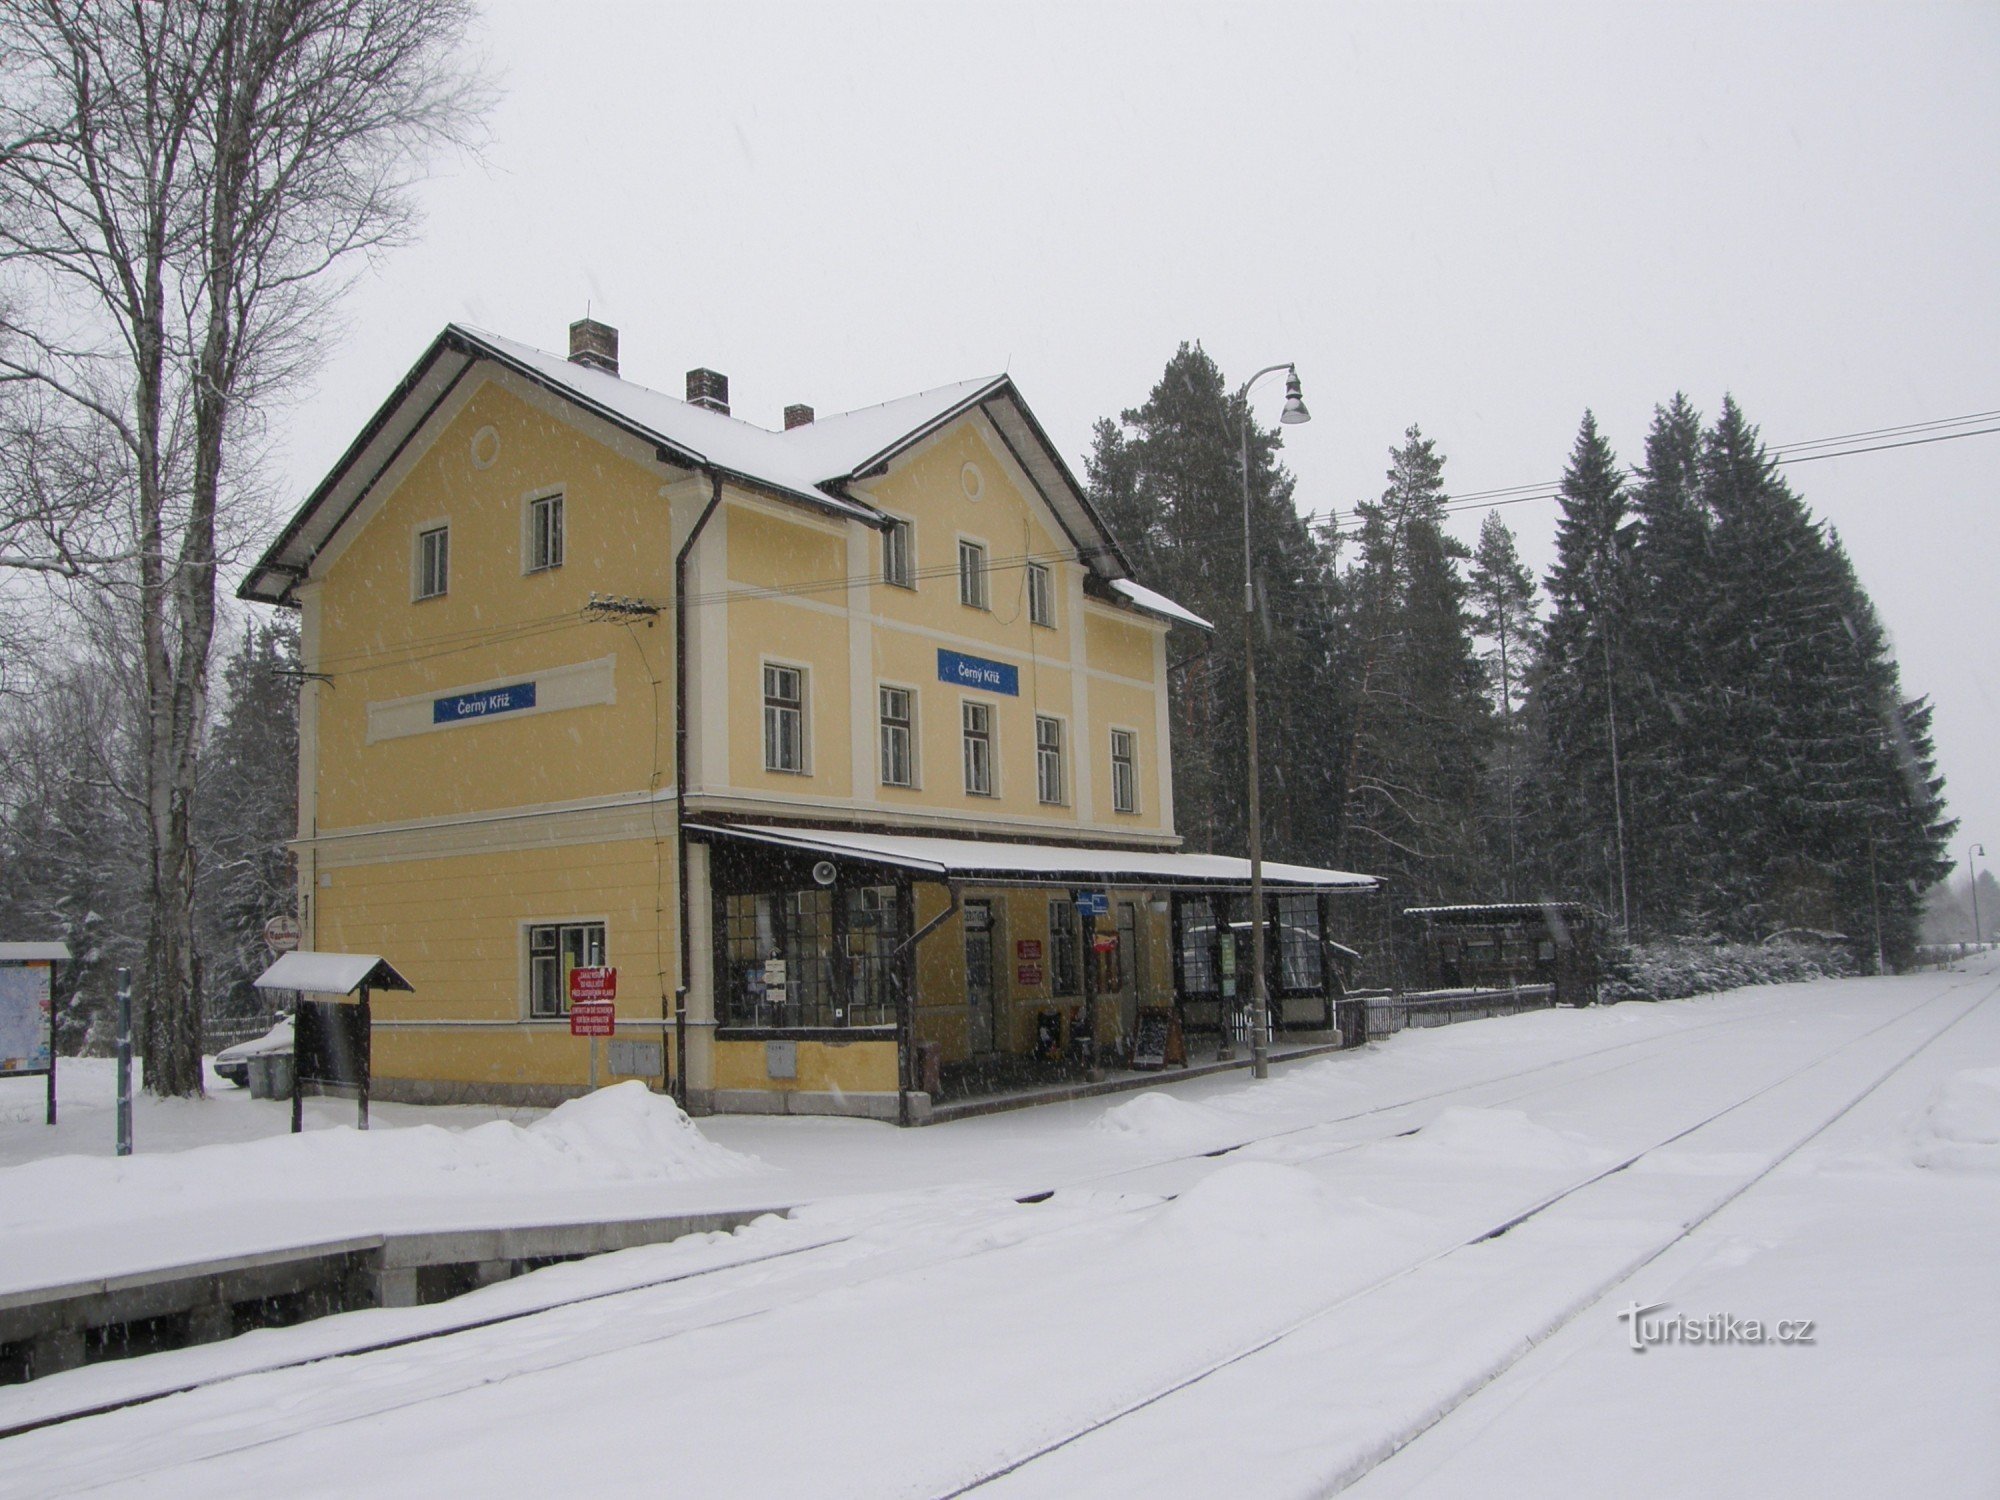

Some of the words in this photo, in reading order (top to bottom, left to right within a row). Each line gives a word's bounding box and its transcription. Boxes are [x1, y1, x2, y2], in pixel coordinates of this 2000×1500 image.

[958, 661, 983, 683] Černý
[984, 669, 1000, 685] Kříž
[457, 697, 487, 715] Černý
[489, 693, 510, 709] Kříž
